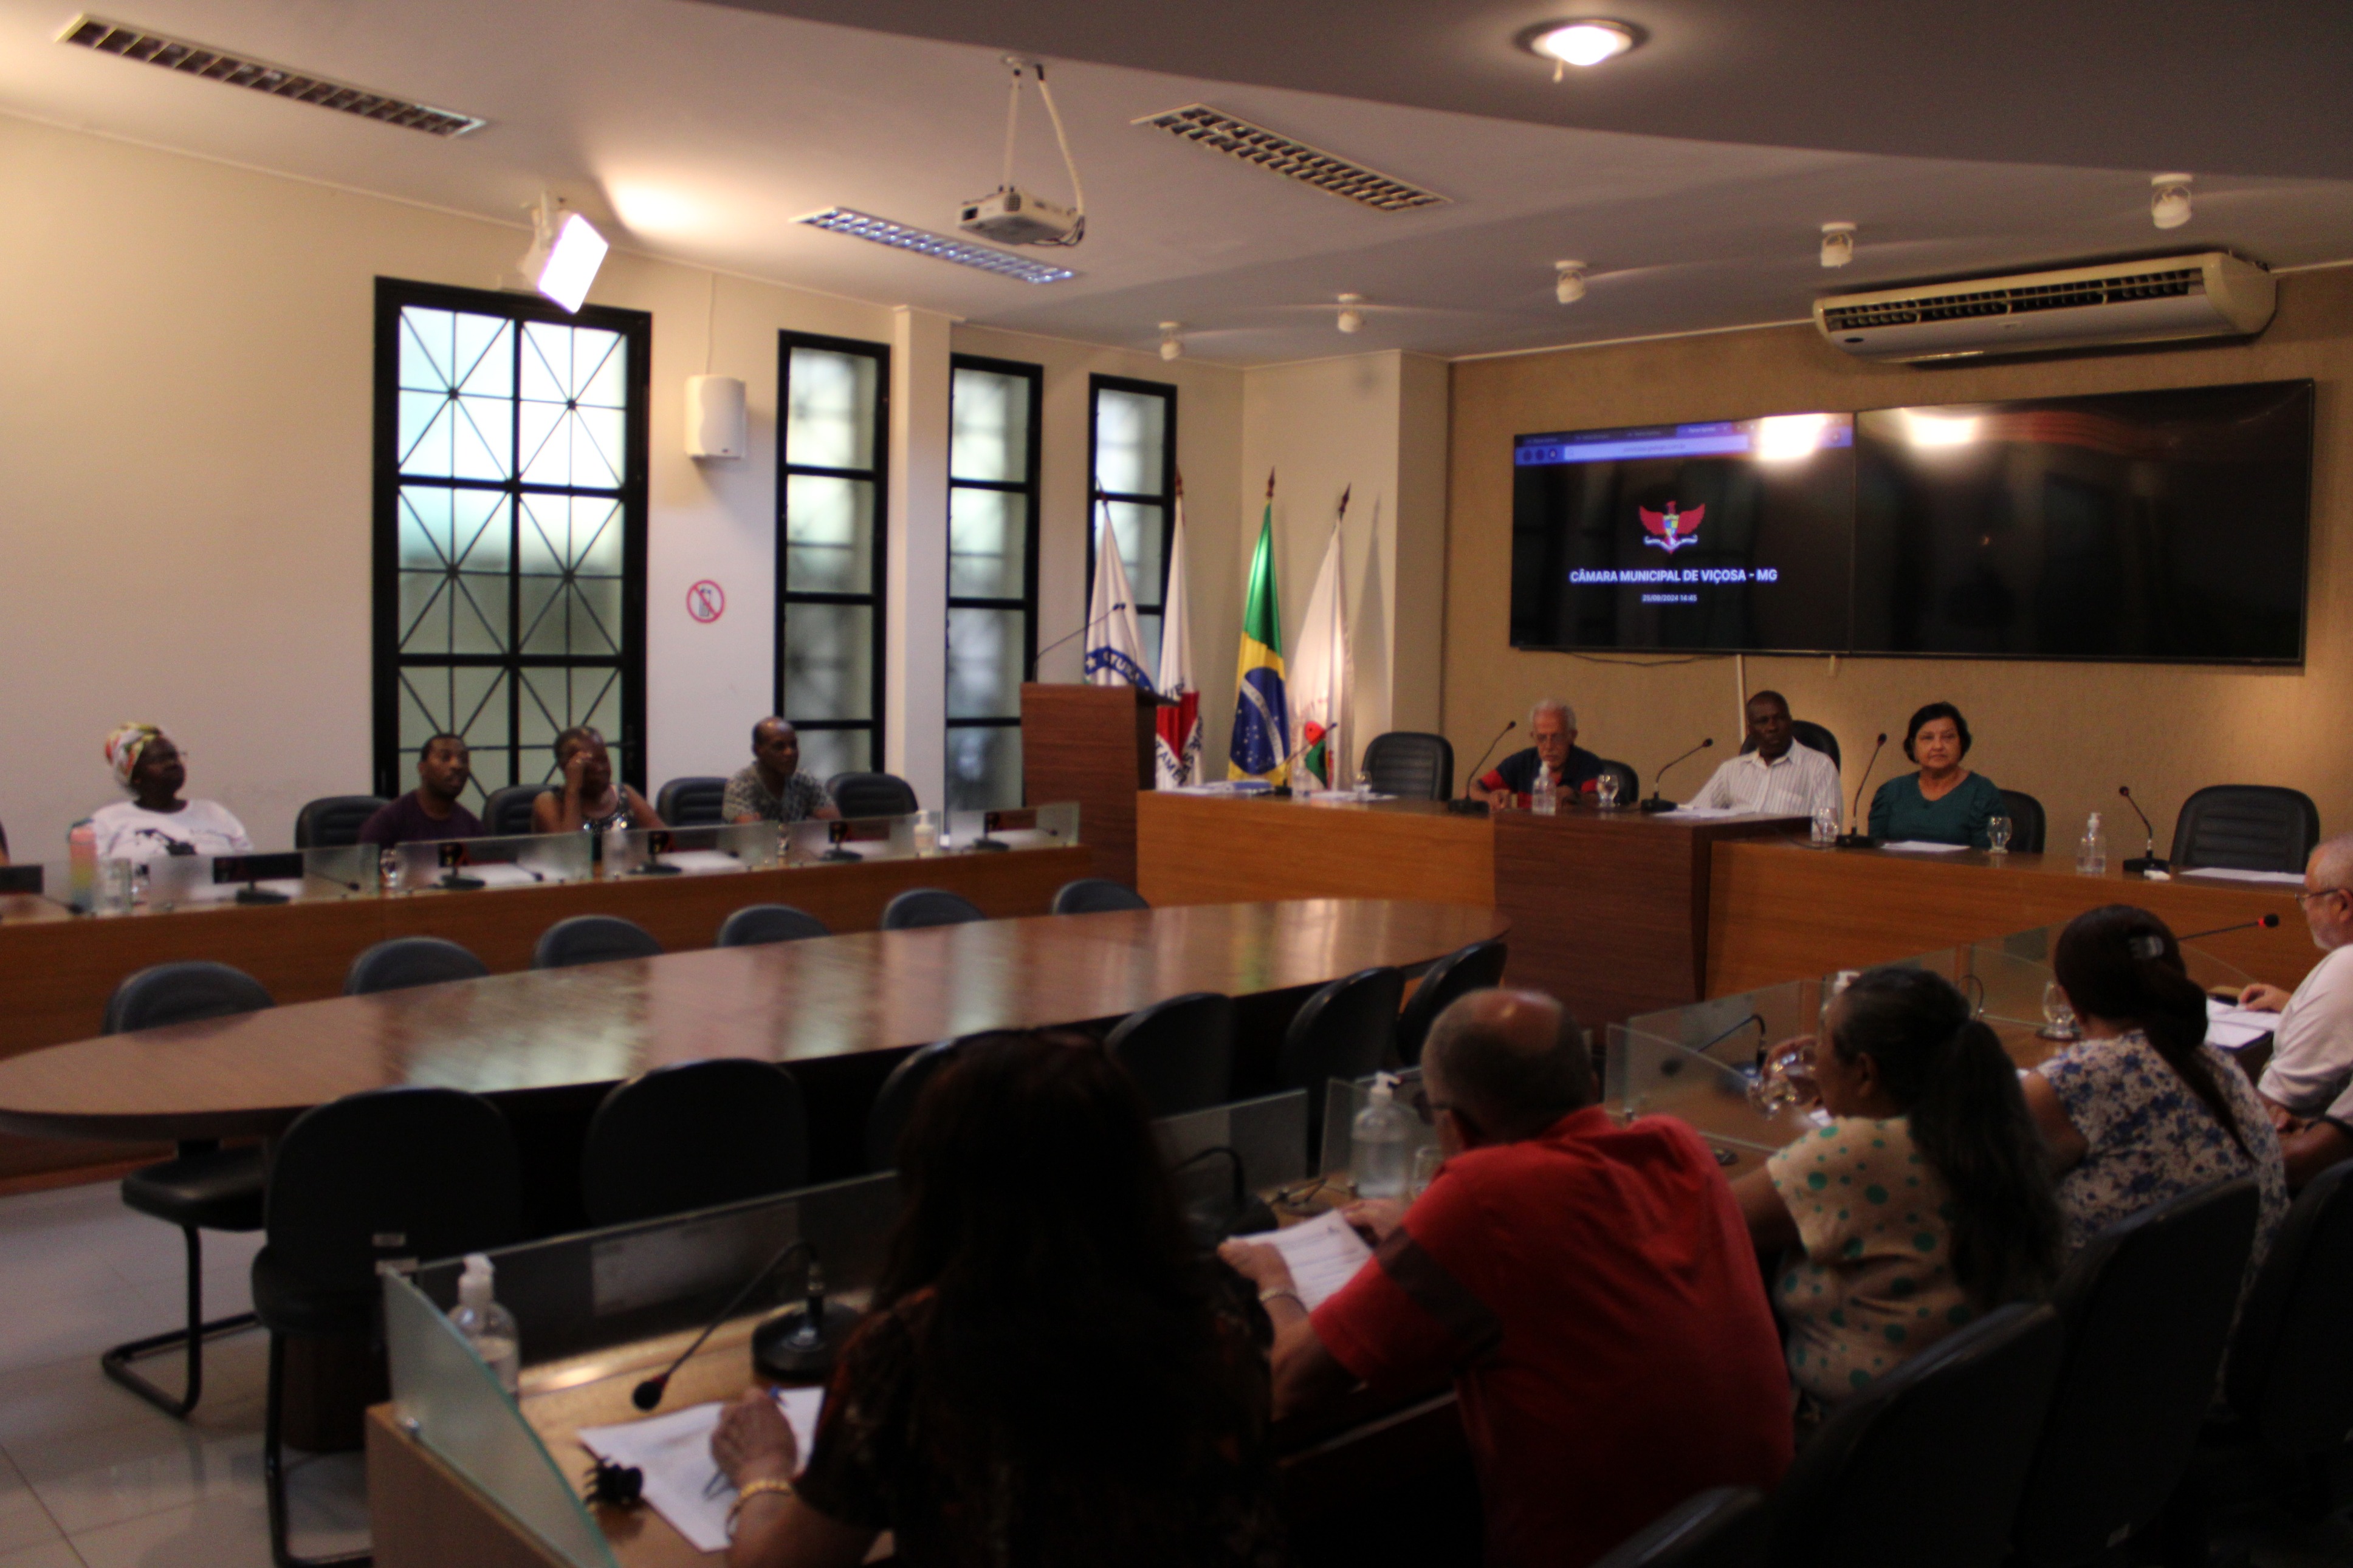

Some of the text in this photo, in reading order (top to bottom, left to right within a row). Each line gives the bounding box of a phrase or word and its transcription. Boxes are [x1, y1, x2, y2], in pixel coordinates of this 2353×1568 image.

[1570, 568, 1618, 583] CÂMARA
[1619, 569, 1681, 583] MUNICIPAL
[1682, 569, 1699, 582] DE
[1700, 569, 1747, 584] VIÇOSA
[1756, 569, 1778, 581] MG
